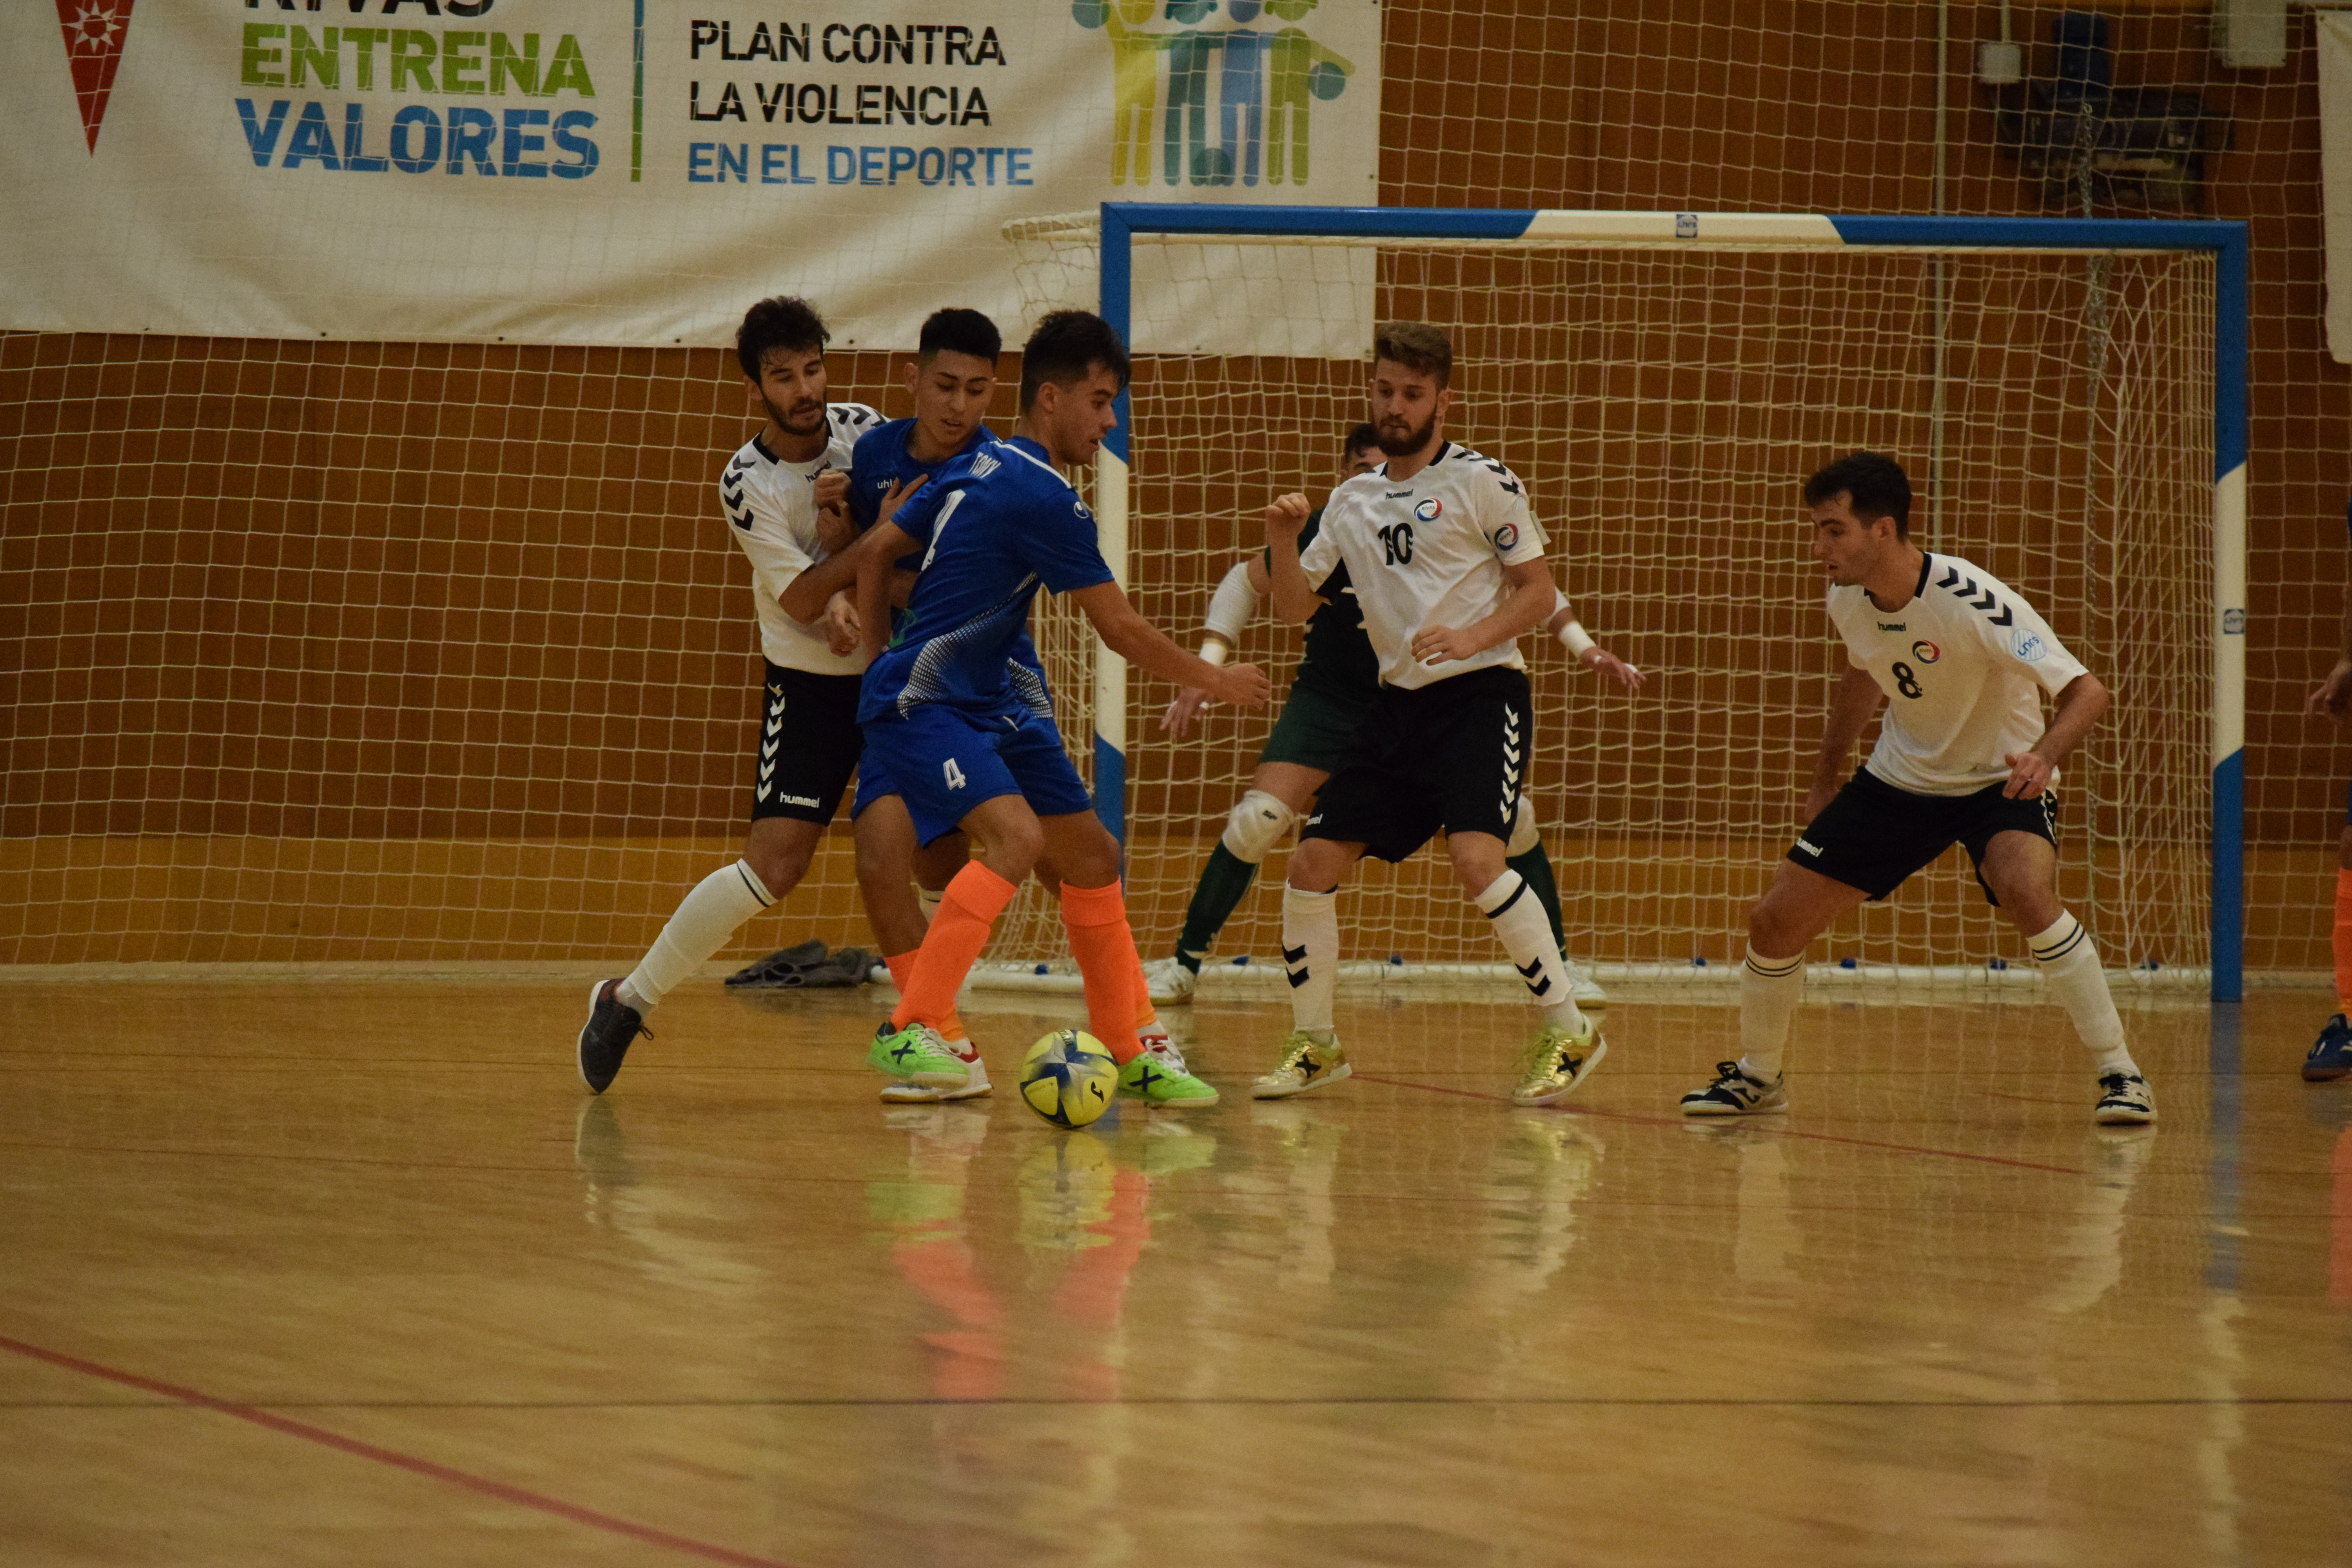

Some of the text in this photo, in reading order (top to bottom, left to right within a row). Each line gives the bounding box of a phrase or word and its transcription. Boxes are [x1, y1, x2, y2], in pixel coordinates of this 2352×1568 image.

[240, 22, 596, 98] ENTRENA
[690, 20, 1007, 66] PLAN CONTRA
[689, 81, 993, 127] LA VIOLENCIA
[234, 98, 600, 179] VALORES
[688, 142, 1034, 186] EN EL DEPORTE
[1385, 488, 1414, 500] hummel
[1377, 522, 1414, 566] 10
[1877, 621, 1907, 632] hummel
[1892, 662, 1923, 699] 8
[943, 757, 966, 790] 4
[779, 791, 820, 808] hummel
